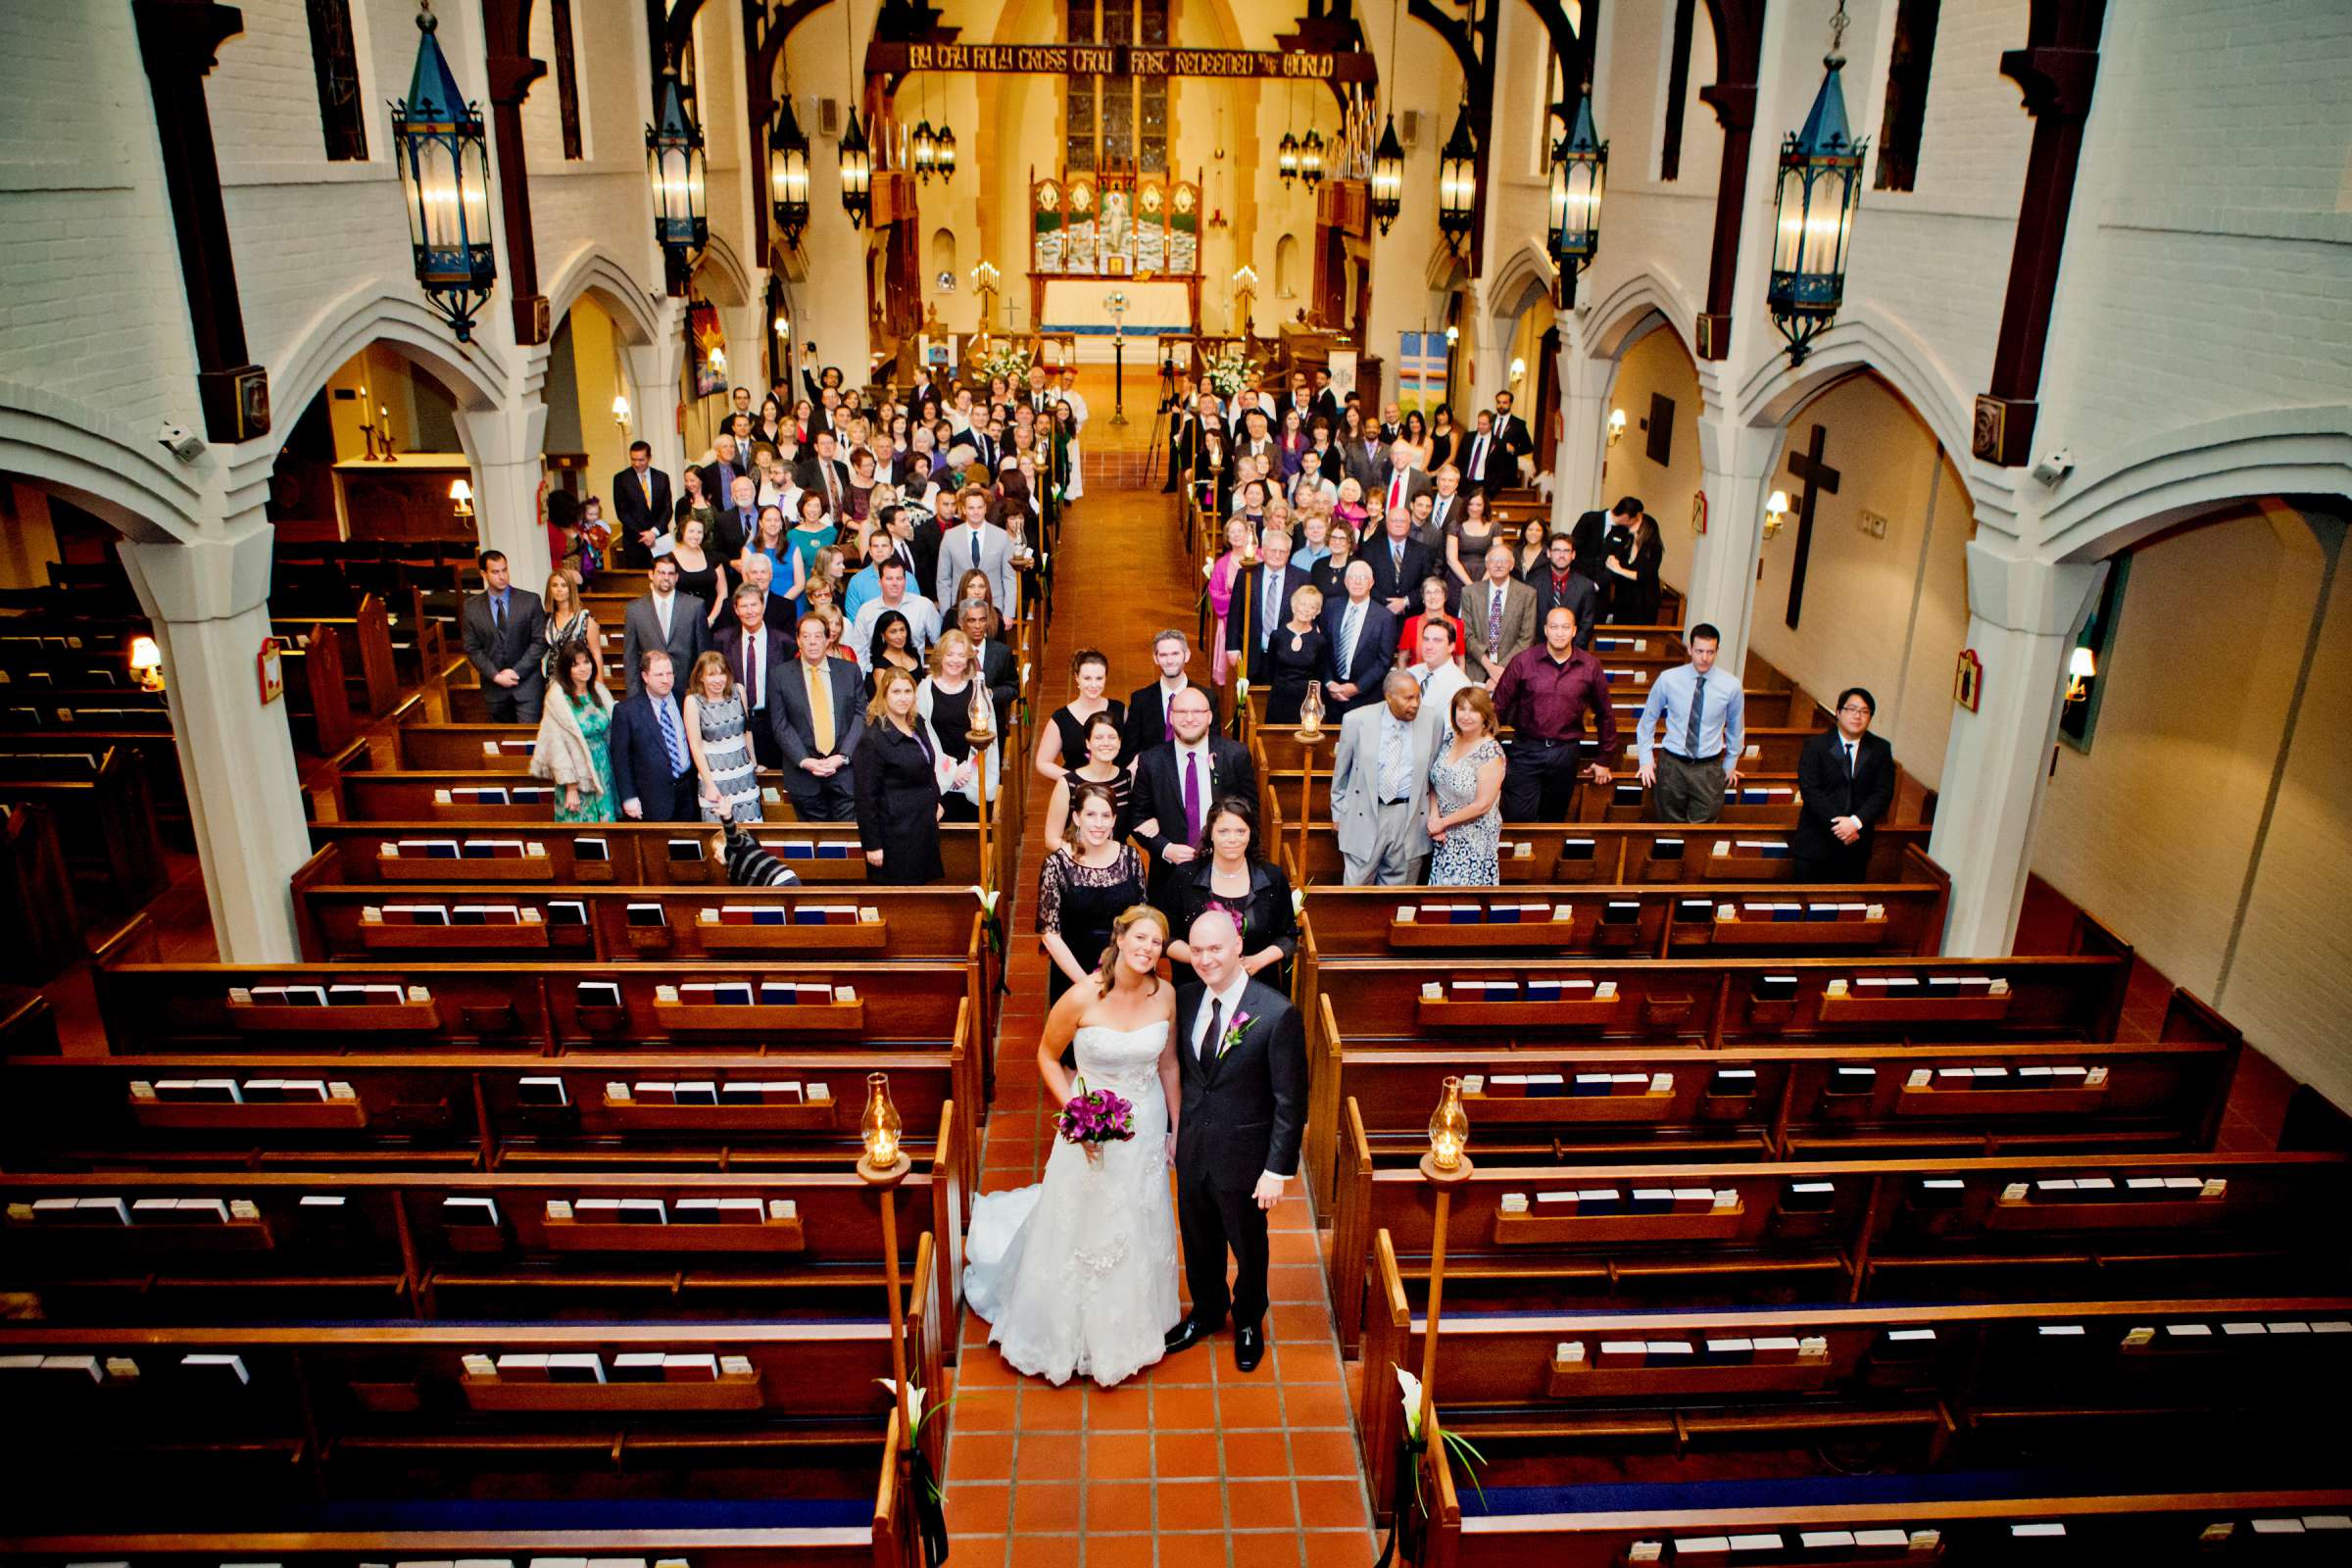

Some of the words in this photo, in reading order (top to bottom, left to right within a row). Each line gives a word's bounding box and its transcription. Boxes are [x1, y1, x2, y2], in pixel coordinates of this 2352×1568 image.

[909, 45, 932, 70] BY
[974, 47, 1012, 72] HOLY
[1018, 48, 1066, 73] CROSS
[1131, 50, 1169, 74] HAST
[1175, 52, 1253, 75] REDEEMED
[1283, 54, 1334, 77] WORLD
